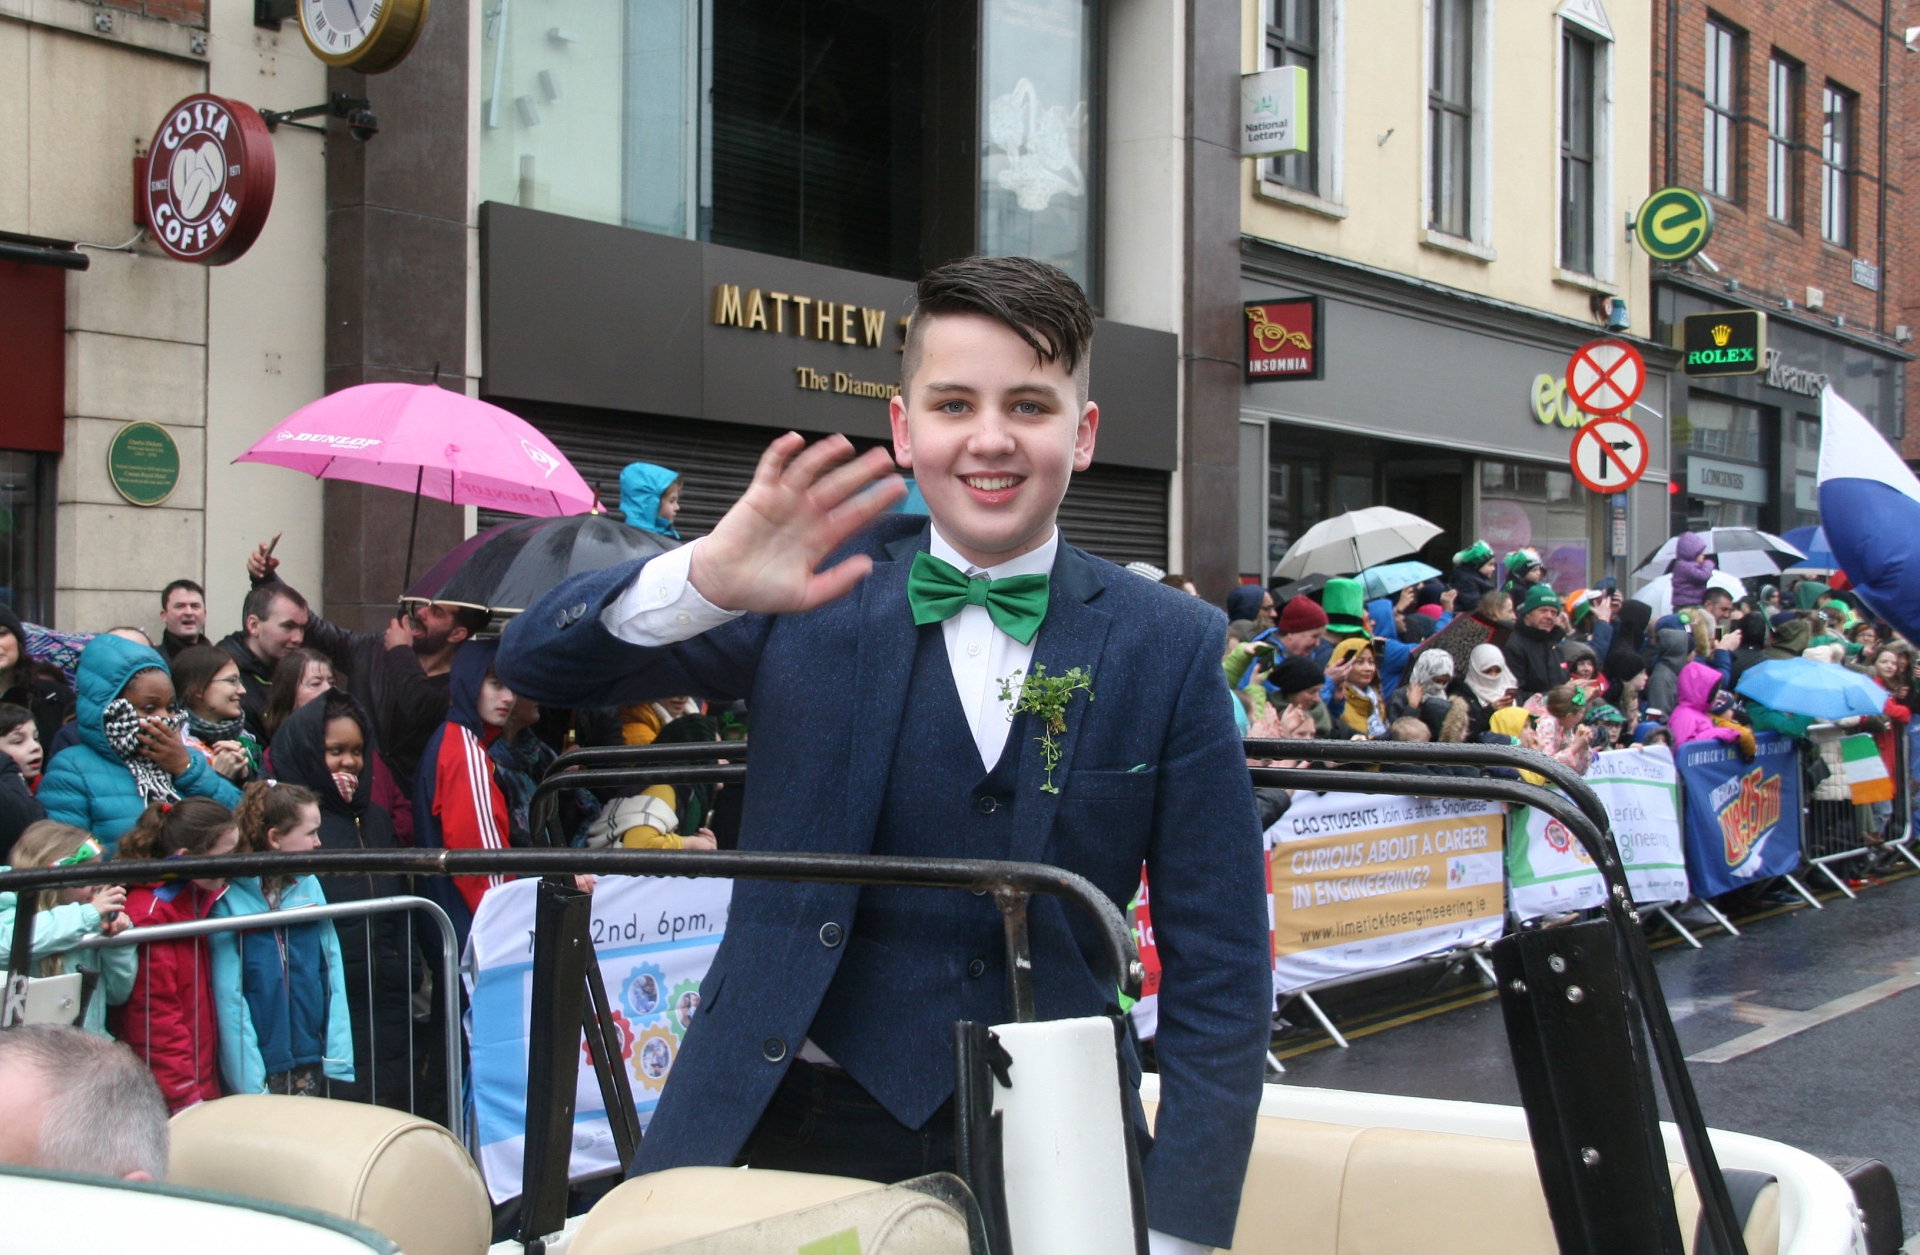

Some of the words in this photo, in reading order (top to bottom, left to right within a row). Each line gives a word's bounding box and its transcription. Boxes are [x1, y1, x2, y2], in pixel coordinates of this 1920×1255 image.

[163, 104, 230, 150] COSTA
[1245, 119, 1288, 133] National
[1248, 130, 1285, 142] Lottery
[229, 165, 241, 177] 1971
[151, 179, 168, 192] SINCE
[156, 193, 237, 250] COFFEE
[1642, 192, 1702, 255] e
[714, 283, 886, 349] MATTHEW
[1249, 357, 1307, 373] INSOMNIA
[1688, 348, 1754, 365] ROLEX
[796, 366, 829, 391] The
[292, 432, 383, 447] DUNLOP
[1701, 467, 1744, 490] LONGINES
[1687, 749, 1725, 767] LIMERICK'S
[1767, 740, 1793, 755] STATION
[1292, 817, 1320, 836] CAO
[1324, 808, 1379, 832] STUDENTS
[1381, 806, 1400, 824] Join
[1403, 808, 1414, 820] us
[1416, 805, 1426, 818] at
[1427, 801, 1440, 816] the
[1441, 799, 1487, 815] Showcase
[1290, 845, 1364, 875] CURIOUS
[1366, 835, 1418, 866] ABOUT
[1422, 833, 1434, 856] A
[1434, 826, 1489, 853] CAREER
[1620, 829, 1670, 863] gineering
[1292, 885, 1312, 910] IN
[1315, 865, 1432, 906] ENGINEERING?
[592, 913, 645, 944] 2nd,
[657, 911, 713, 942] 6pm,
